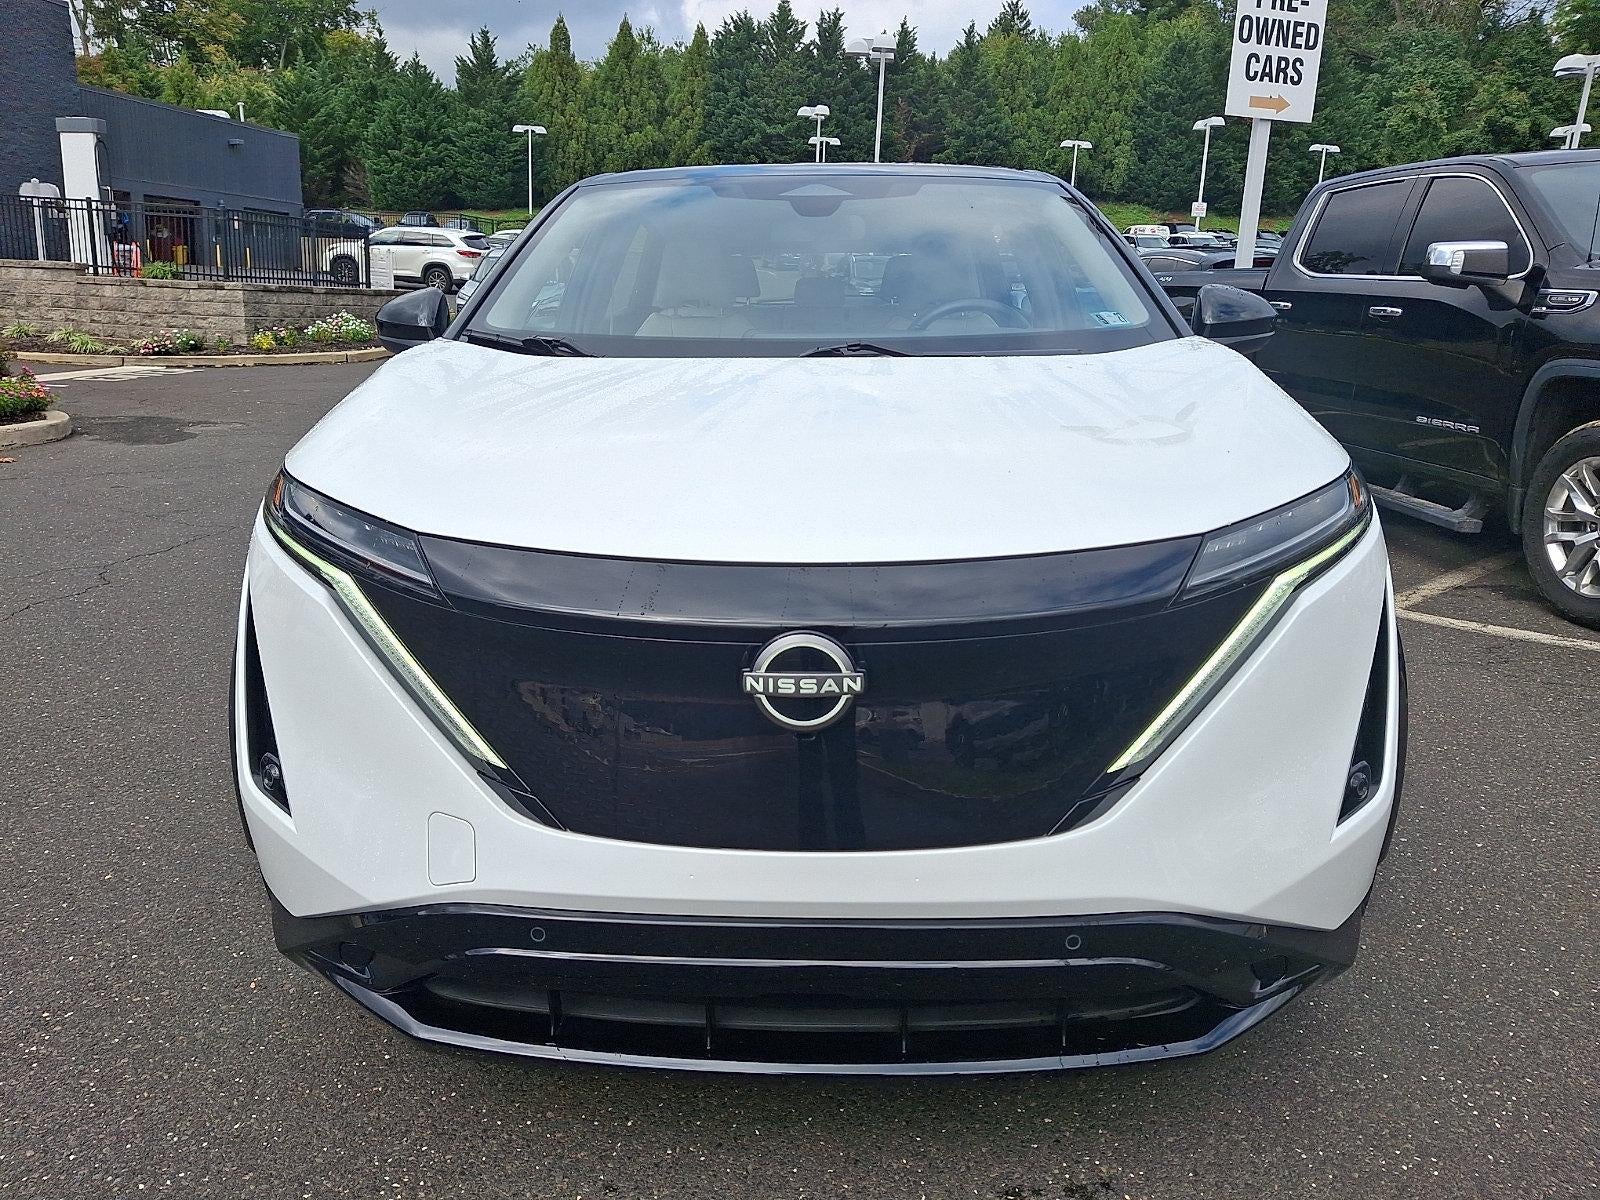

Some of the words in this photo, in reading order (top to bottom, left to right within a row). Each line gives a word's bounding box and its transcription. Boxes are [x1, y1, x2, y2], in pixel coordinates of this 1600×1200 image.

[1238, 14, 1320, 51] OWNED
[1244, 52, 1305, 86] CARS
[1415, 415, 1480, 434] SIERRA
[745, 675, 862, 695] NISSAN
